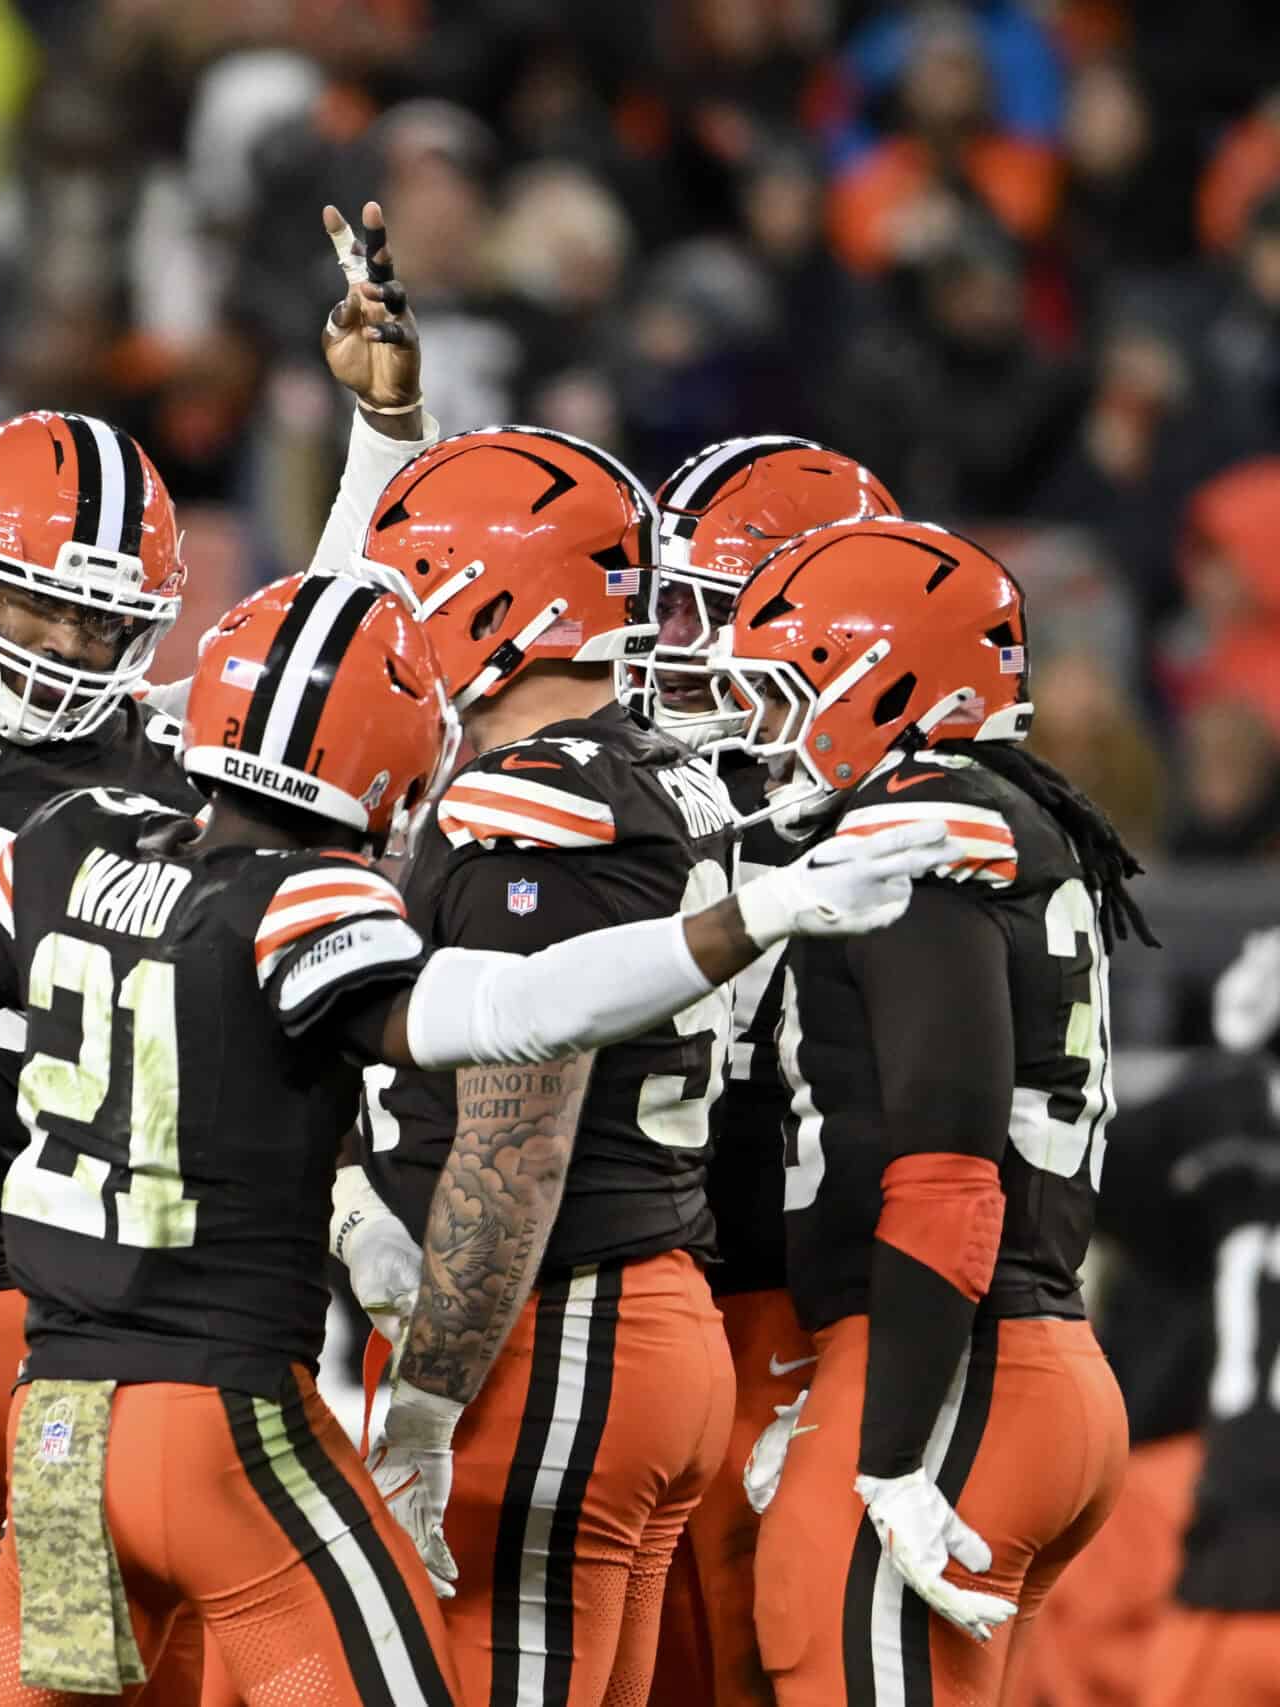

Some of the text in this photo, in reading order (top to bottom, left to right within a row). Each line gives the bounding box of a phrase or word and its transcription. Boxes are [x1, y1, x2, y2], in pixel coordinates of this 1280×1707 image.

[223, 717, 240, 748] 2
[223, 756, 320, 803] CLEVELAND
[66, 846, 192, 939] WARD
[1, 931, 199, 1248] 21
